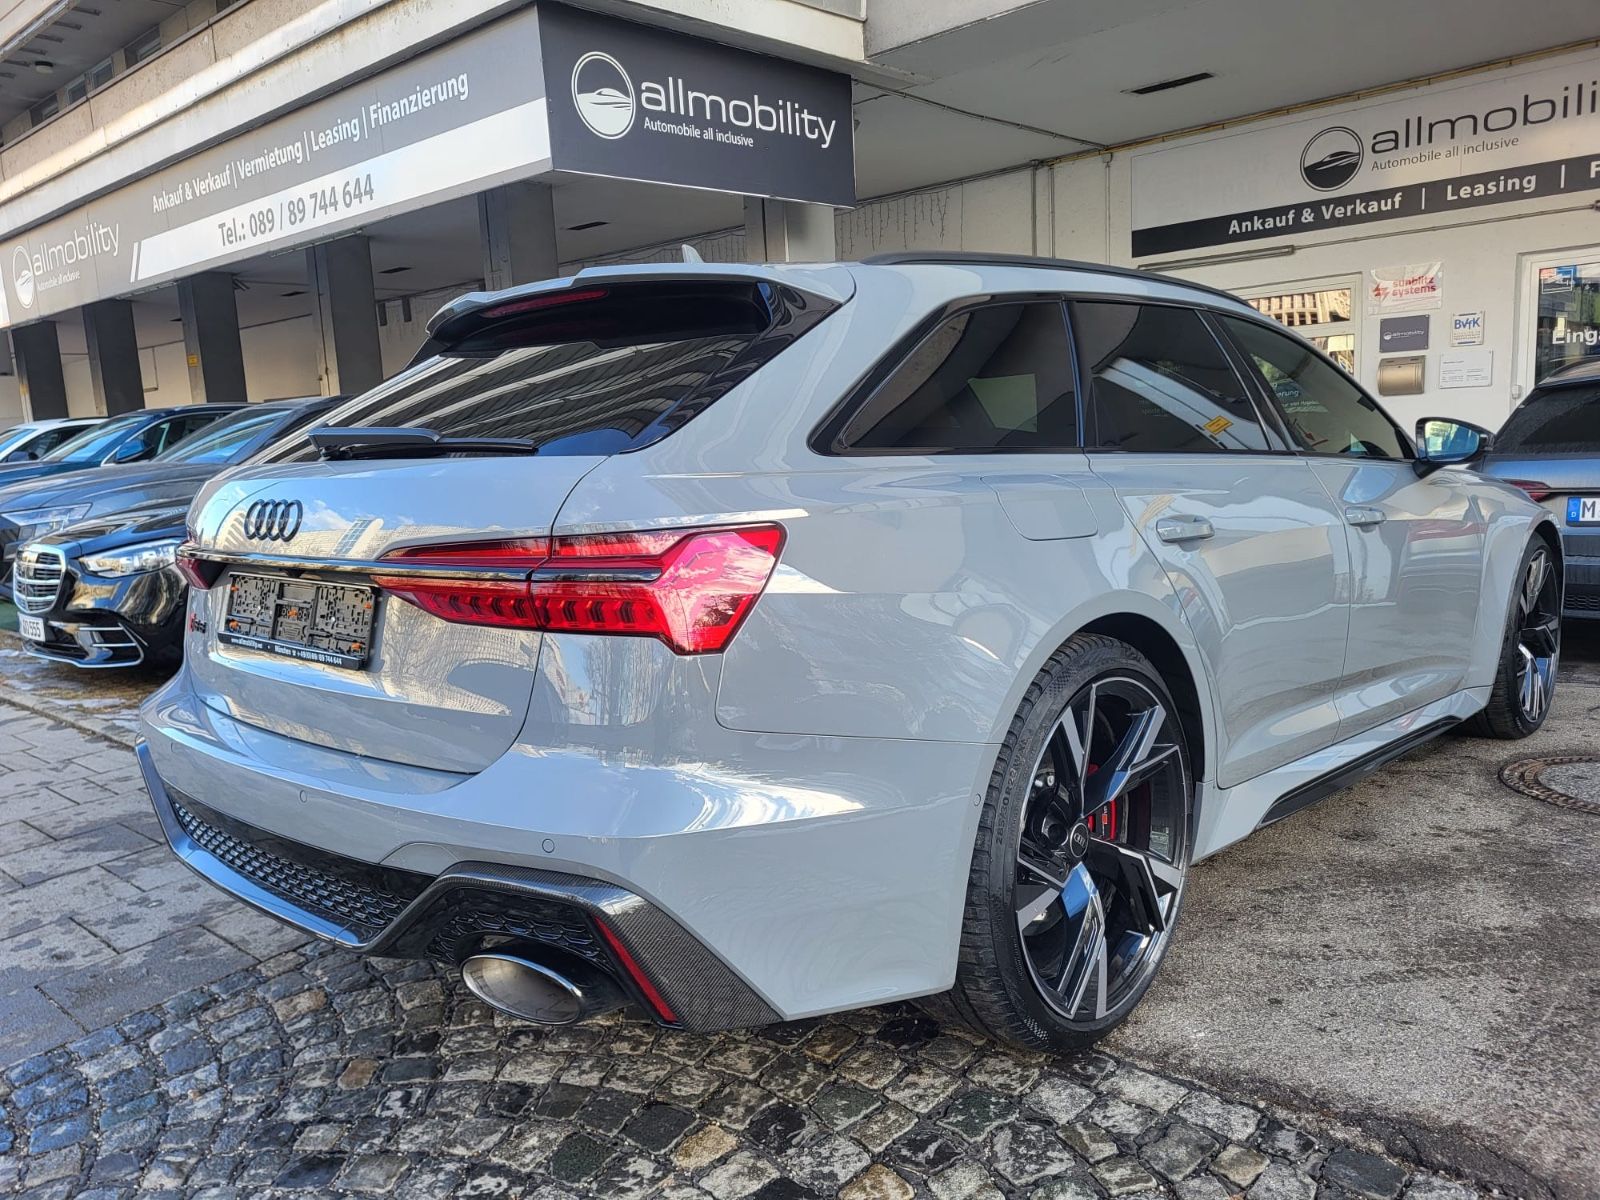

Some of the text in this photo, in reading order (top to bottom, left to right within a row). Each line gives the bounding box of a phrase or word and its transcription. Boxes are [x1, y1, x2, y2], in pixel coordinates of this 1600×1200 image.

[640, 77, 836, 149] allmobility
[643, 116, 754, 147] Automobile all inclusive
[152, 189, 183, 213] Ankauf
[184, 182, 193, 201] &
[192, 164, 231, 198] Verkauf
[237, 141, 303, 180] Vermietung
[310, 117, 360, 152] Leasing
[369, 72, 469, 129] Finanzierung
[1371, 136, 1520, 171] Automobile all inclusive
[218, 217, 246, 247] Tel.:
[249, 207, 275, 238] 089
[287, 197, 306, 226] 89
[309, 186, 339, 219] 744
[342, 173, 375, 208] 644
[1228, 209, 1296, 235] Ankauf
[1301, 207, 1315, 223] &
[1321, 192, 1403, 220] Verkauf
[1446, 174, 1537, 201] Leasing
[32, 221, 119, 276] allmobility
[1392, 285, 1437, 298] systems
[1552, 327, 1600, 346] Eing
[1582, 500, 1596, 518] M
